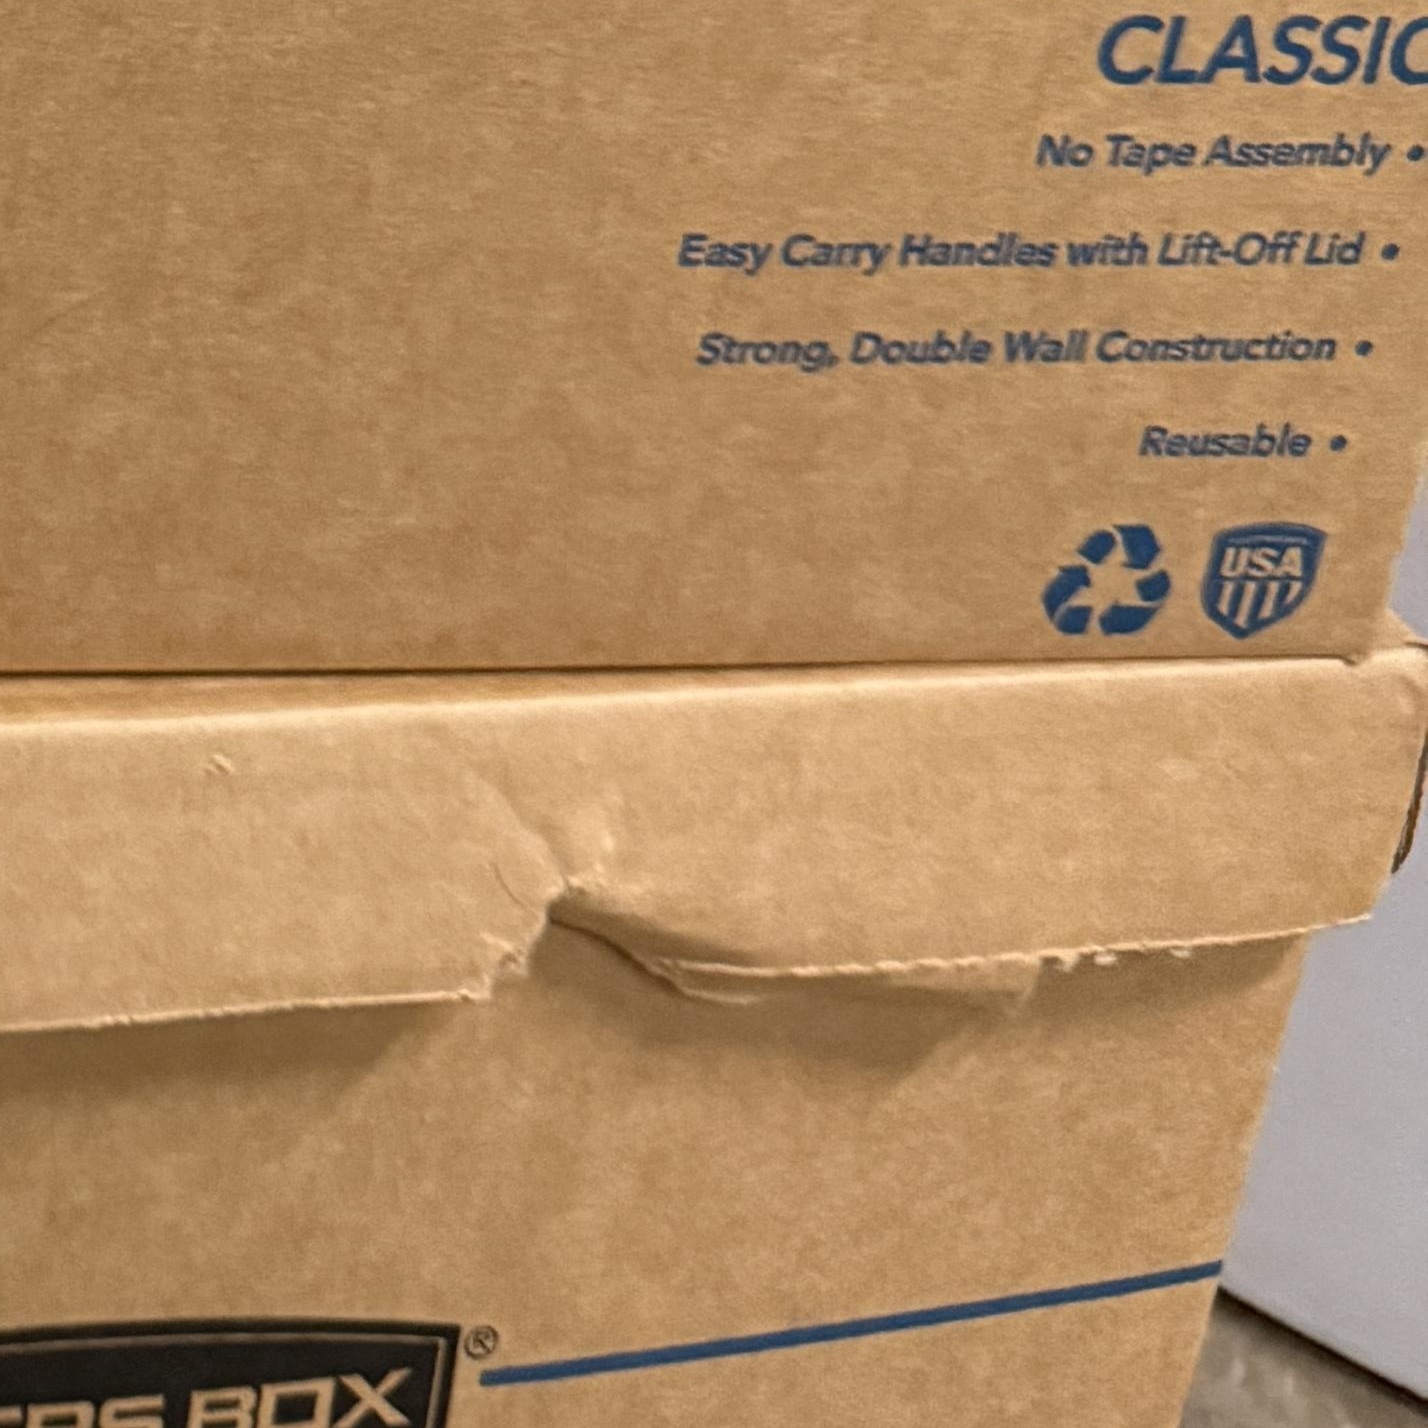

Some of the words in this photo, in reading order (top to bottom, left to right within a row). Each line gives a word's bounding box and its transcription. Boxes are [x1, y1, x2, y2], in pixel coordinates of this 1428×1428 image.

[1096, 14, 1428, 86] CLASSIC
[1035, 134, 1094, 168] No
[1105, 133, 1196, 176] Tape
[1202, 131, 1392, 176] Assembly
[677, 233, 773, 277] Easy
[781, 232, 893, 277] Carry
[898, 231, 1057, 268] Handles
[1066, 230, 1149, 267] with
[1156, 229, 1305, 267] Lift-Off
[1304, 230, 1366, 266] Lid
[695, 331, 840, 374] Strong,
[849, 329, 993, 366] Double
[1003, 329, 1090, 365] Wall
[1095, 328, 1337, 364] Construction
[1138, 424, 1313, 457] Reusable
[1219, 546, 1303, 579] USA
